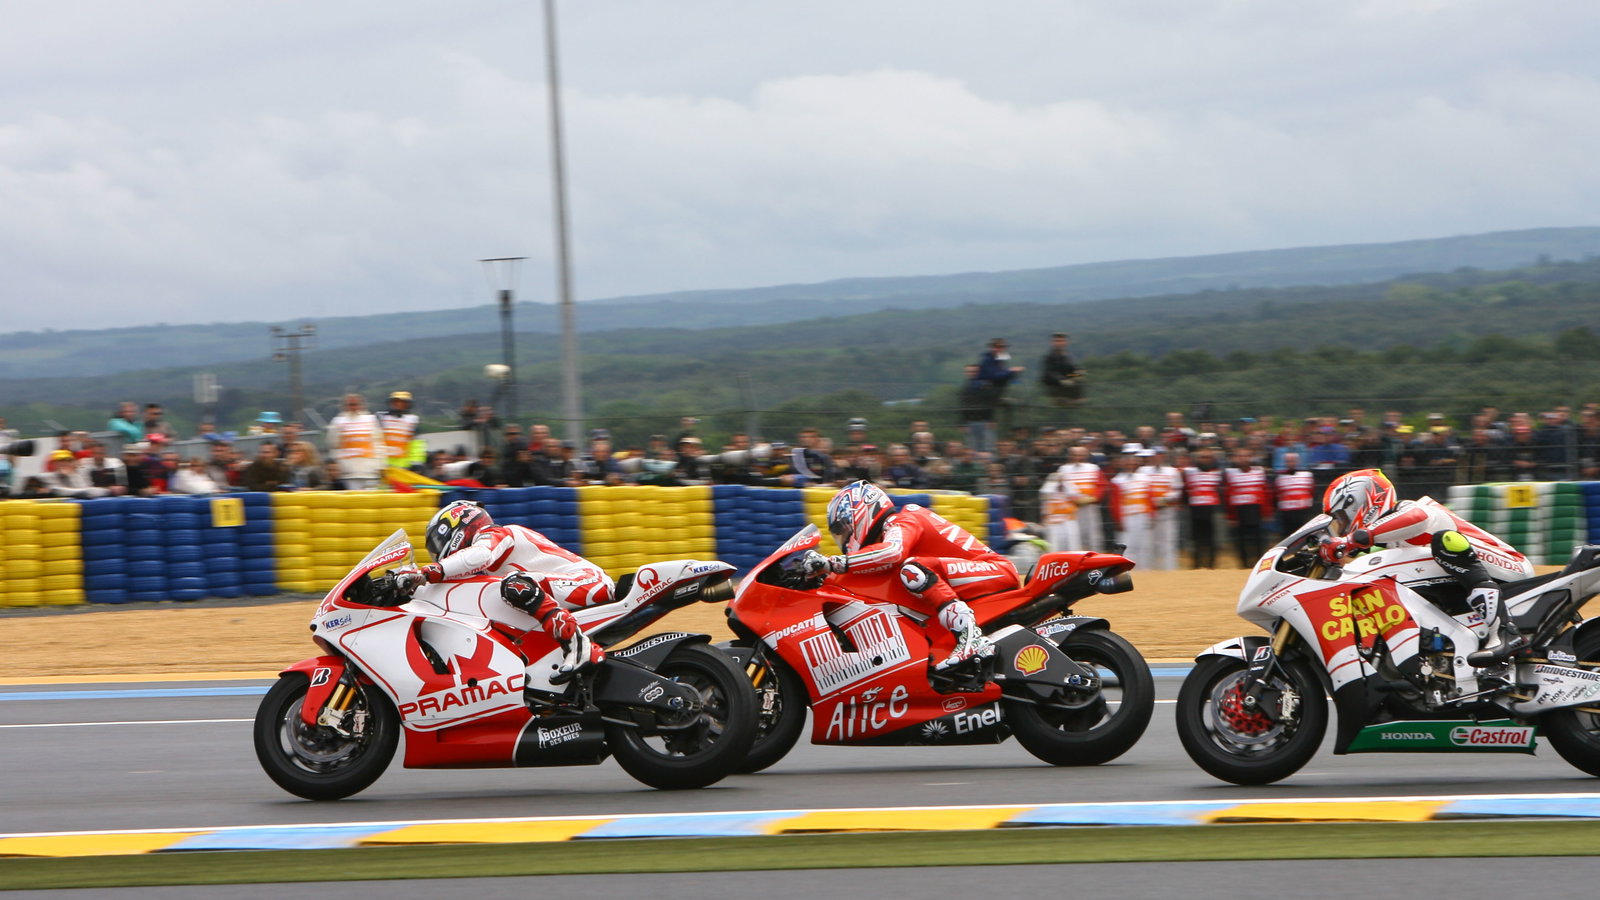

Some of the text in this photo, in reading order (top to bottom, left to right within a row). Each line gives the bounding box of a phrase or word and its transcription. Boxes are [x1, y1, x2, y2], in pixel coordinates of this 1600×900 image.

[1036, 561, 1070, 581] Alice
[1476, 551, 1525, 575] HONDA
[636, 577, 673, 604] PRAMAC
[1329, 589, 1386, 617] SAN
[776, 618, 815, 641] DUCATI
[1321, 604, 1406, 641] CARLO
[399, 673, 524, 721] PRAMAC
[825, 685, 909, 741] Alice
[953, 701, 1001, 735] Enel
[543, 722, 583, 742] BOXEUR
[1381, 732, 1436, 741] HONDA
[1470, 728, 1528, 745] Castrol
